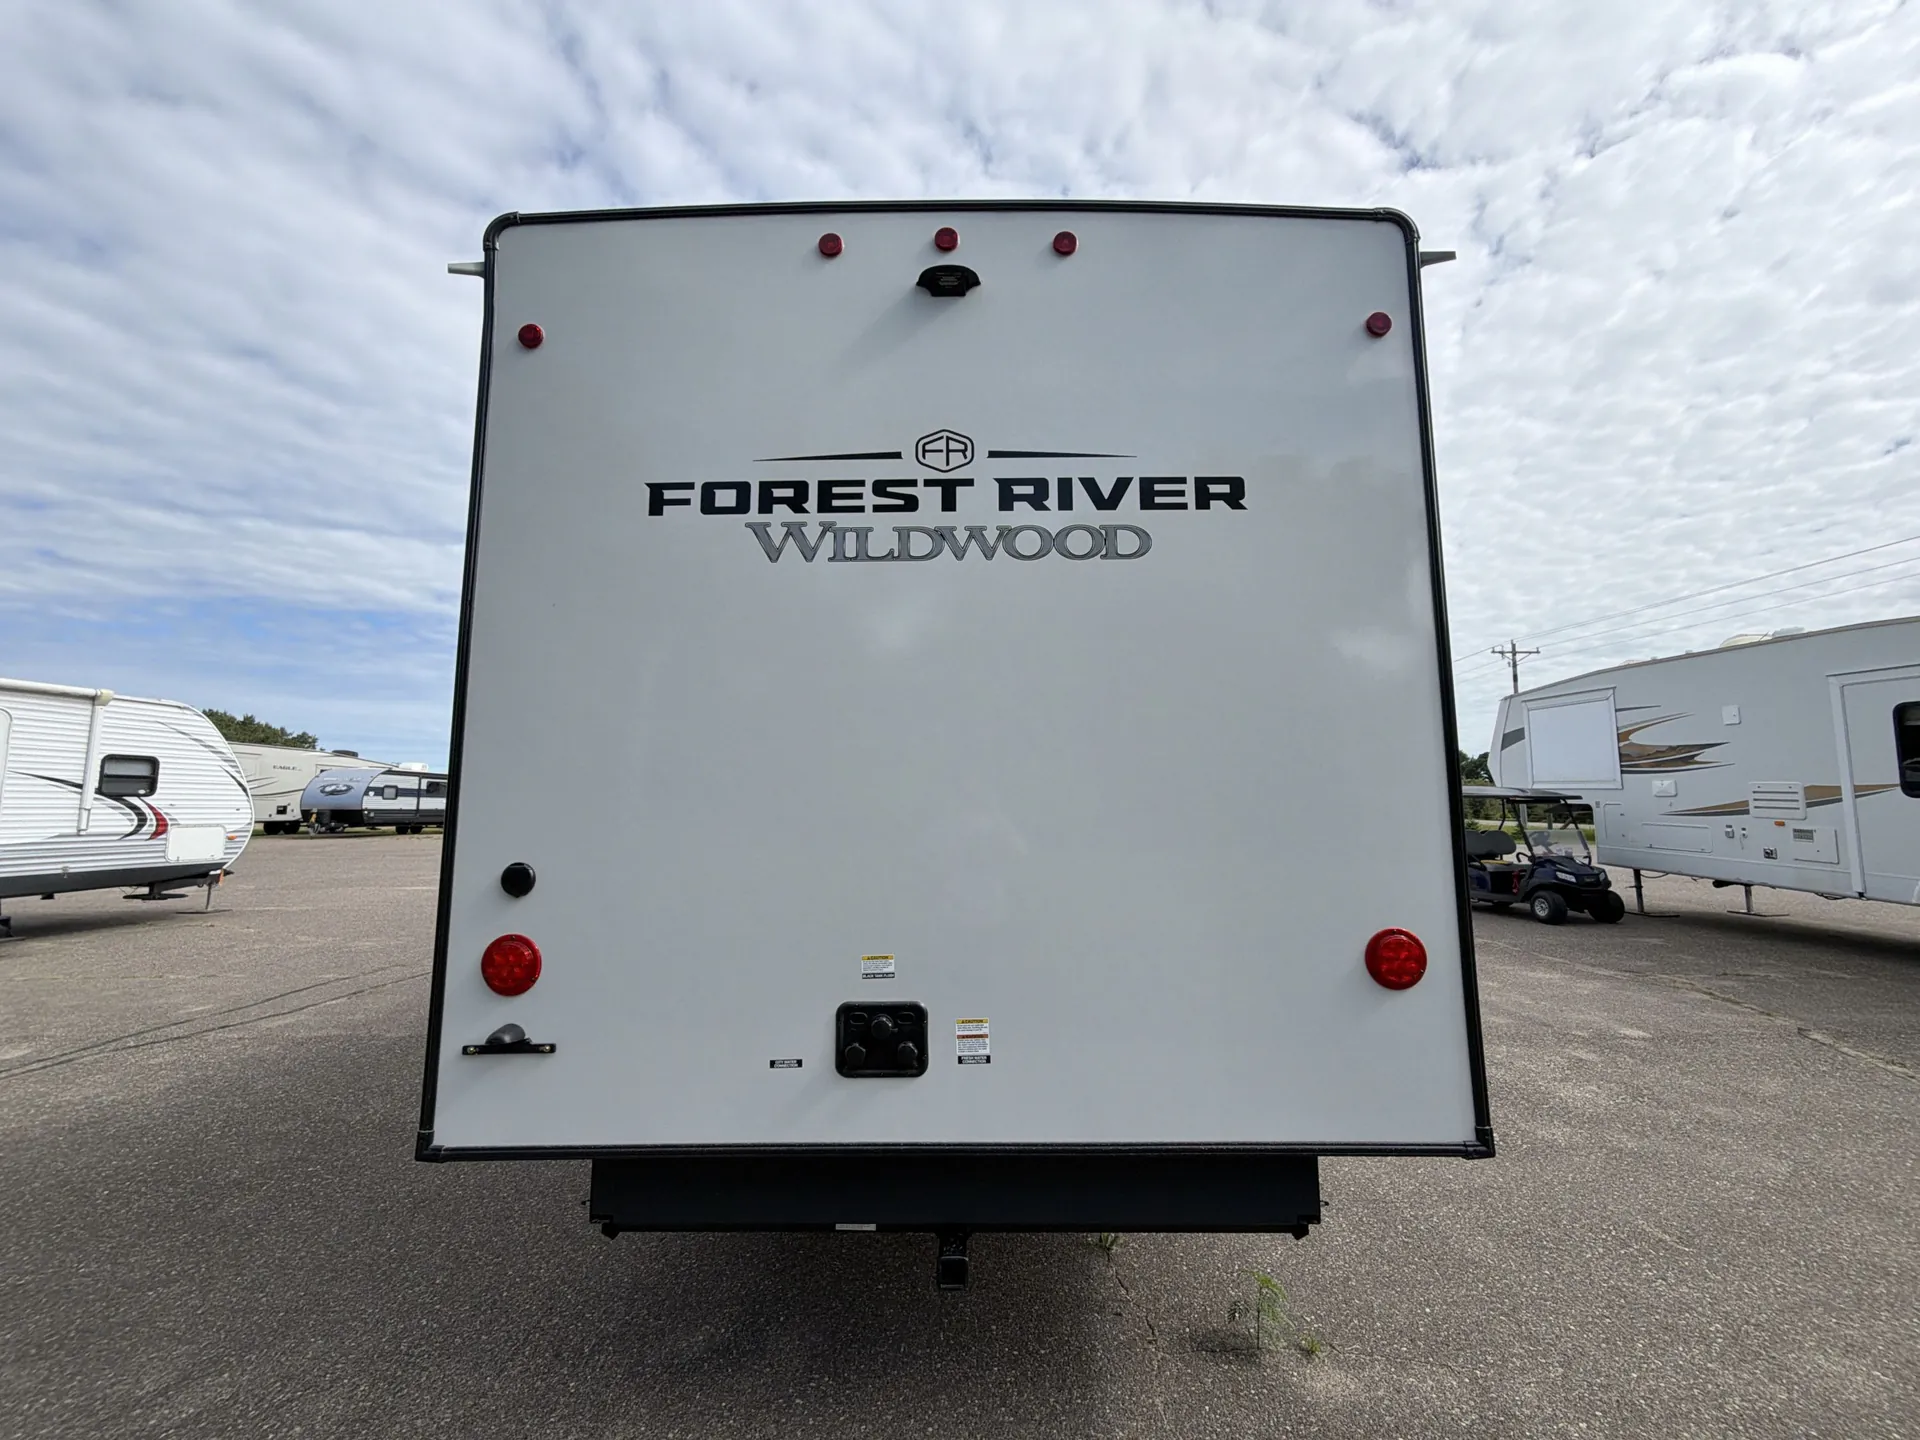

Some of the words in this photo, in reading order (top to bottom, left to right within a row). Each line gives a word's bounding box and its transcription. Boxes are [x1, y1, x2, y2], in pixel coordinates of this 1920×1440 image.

[644, 478, 974, 516] FOREST
[992, 476, 1248, 512] RIVER
[744, 520, 1153, 563] WILDWOOD
